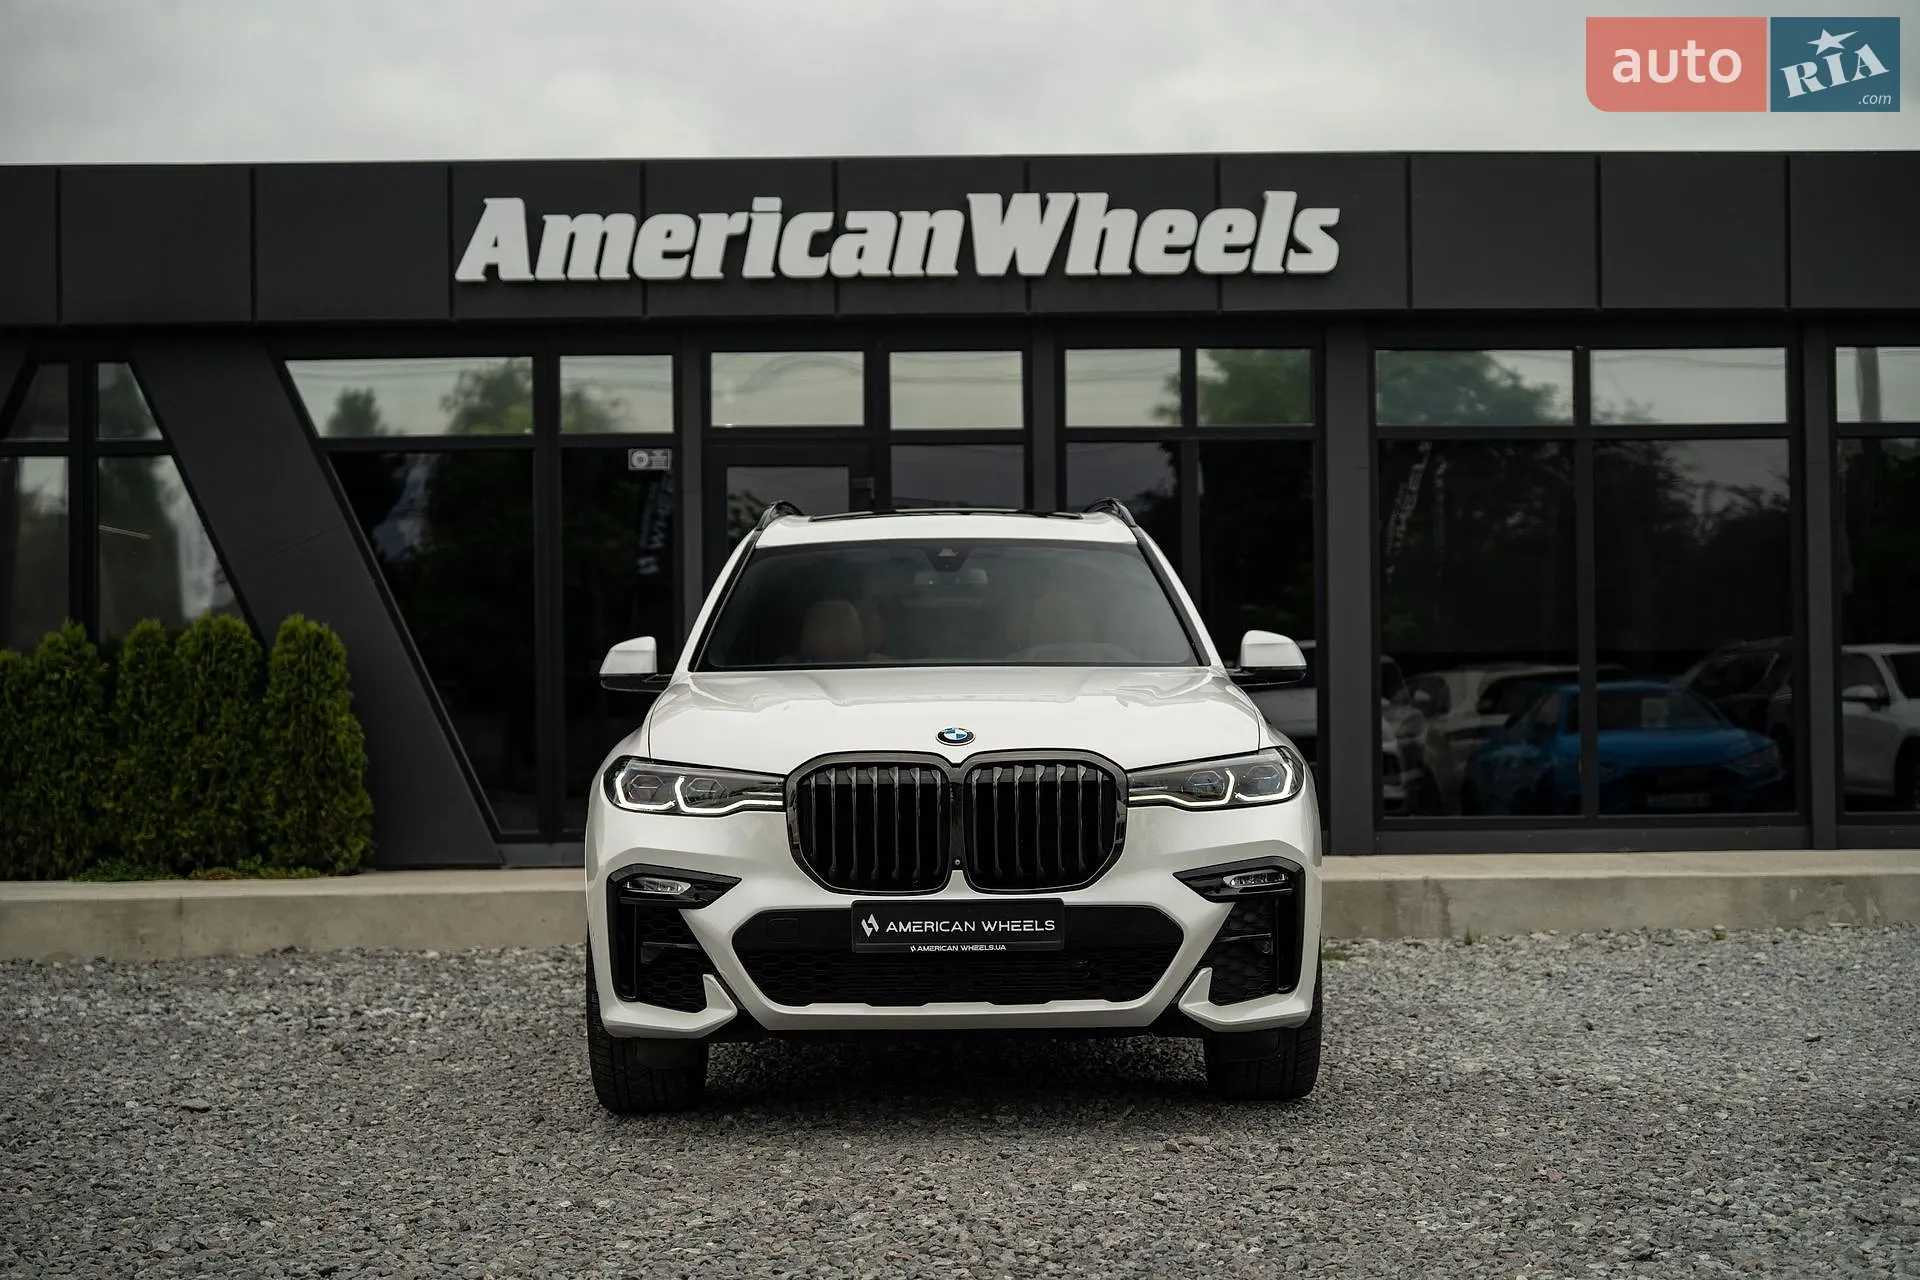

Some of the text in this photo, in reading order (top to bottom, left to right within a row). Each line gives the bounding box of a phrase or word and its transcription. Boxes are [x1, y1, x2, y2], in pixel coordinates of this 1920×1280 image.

[885, 919, 1056, 933] AMERICAN WHEELS
[917, 944, 959, 952] AMERICAN
